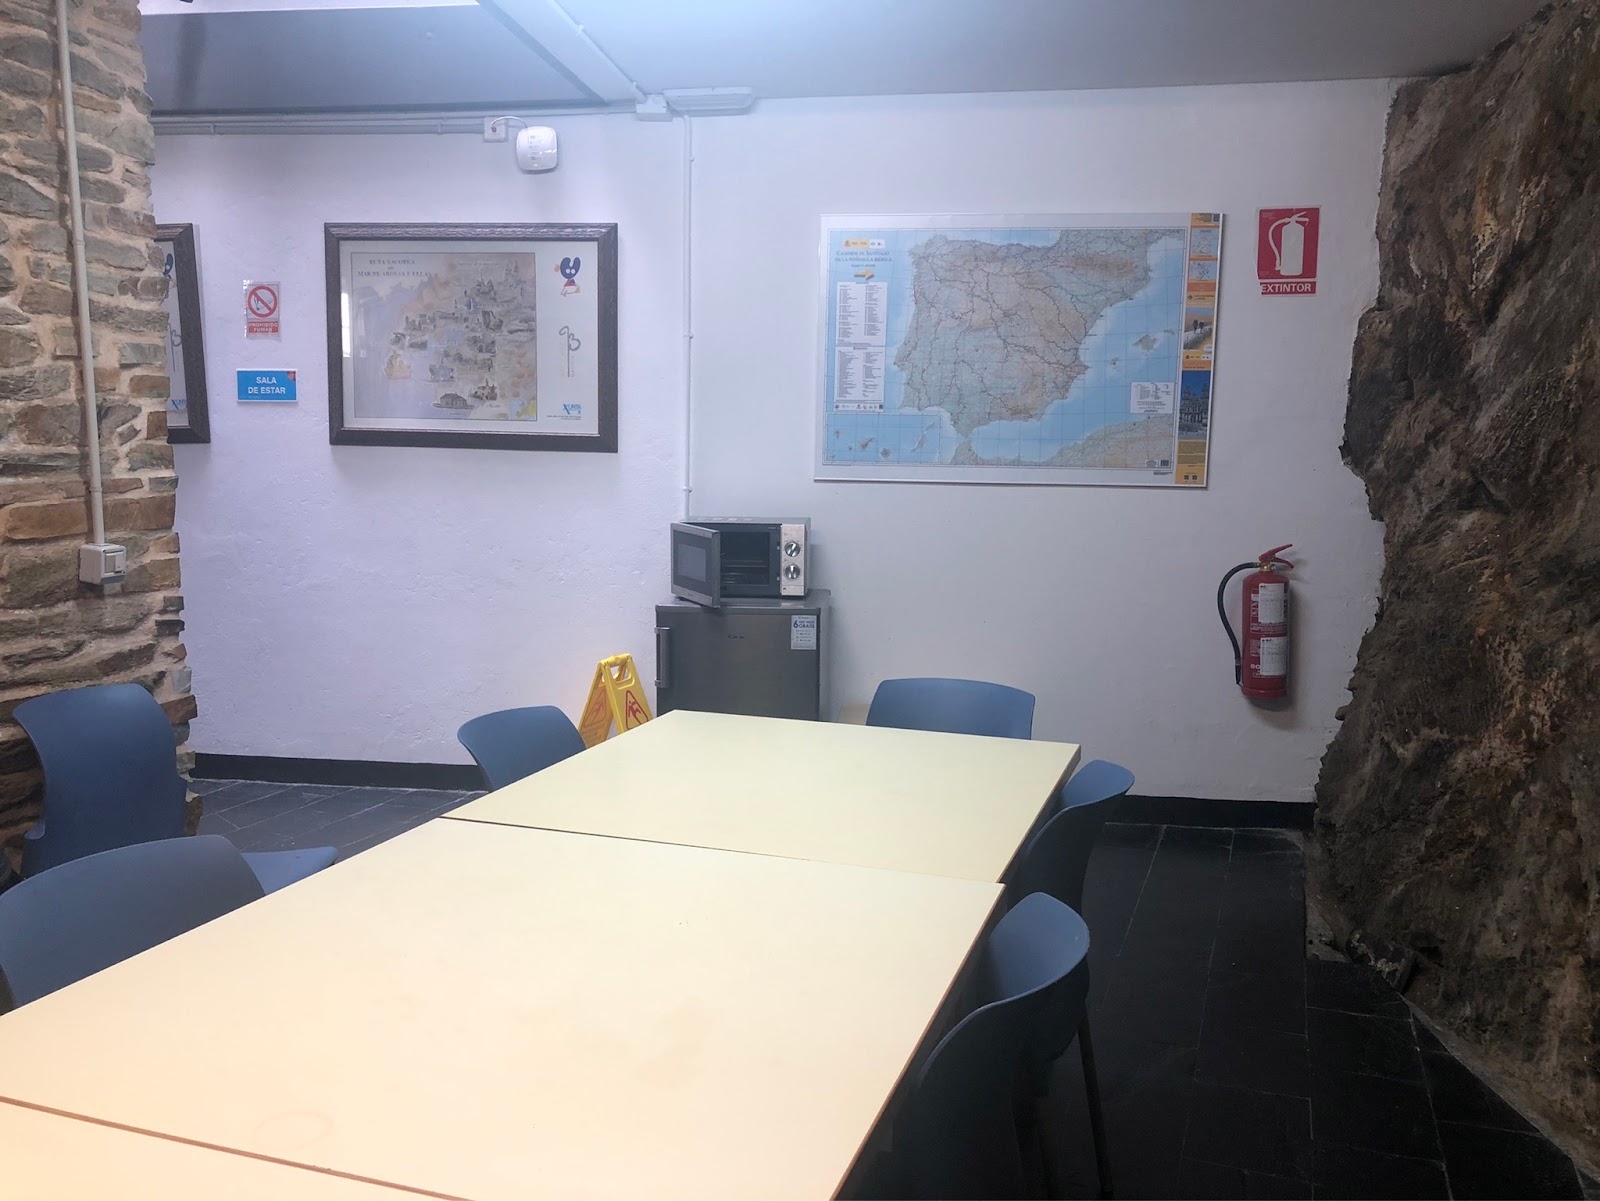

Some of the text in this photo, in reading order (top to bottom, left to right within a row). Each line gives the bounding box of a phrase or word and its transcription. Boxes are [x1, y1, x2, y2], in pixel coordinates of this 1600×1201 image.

[1261, 283, 1312, 293] EXTINTOR
[256, 376, 277, 384] SALA
[247, 386, 286, 395] DE ESTAR
[793, 620, 799, 628] 6
